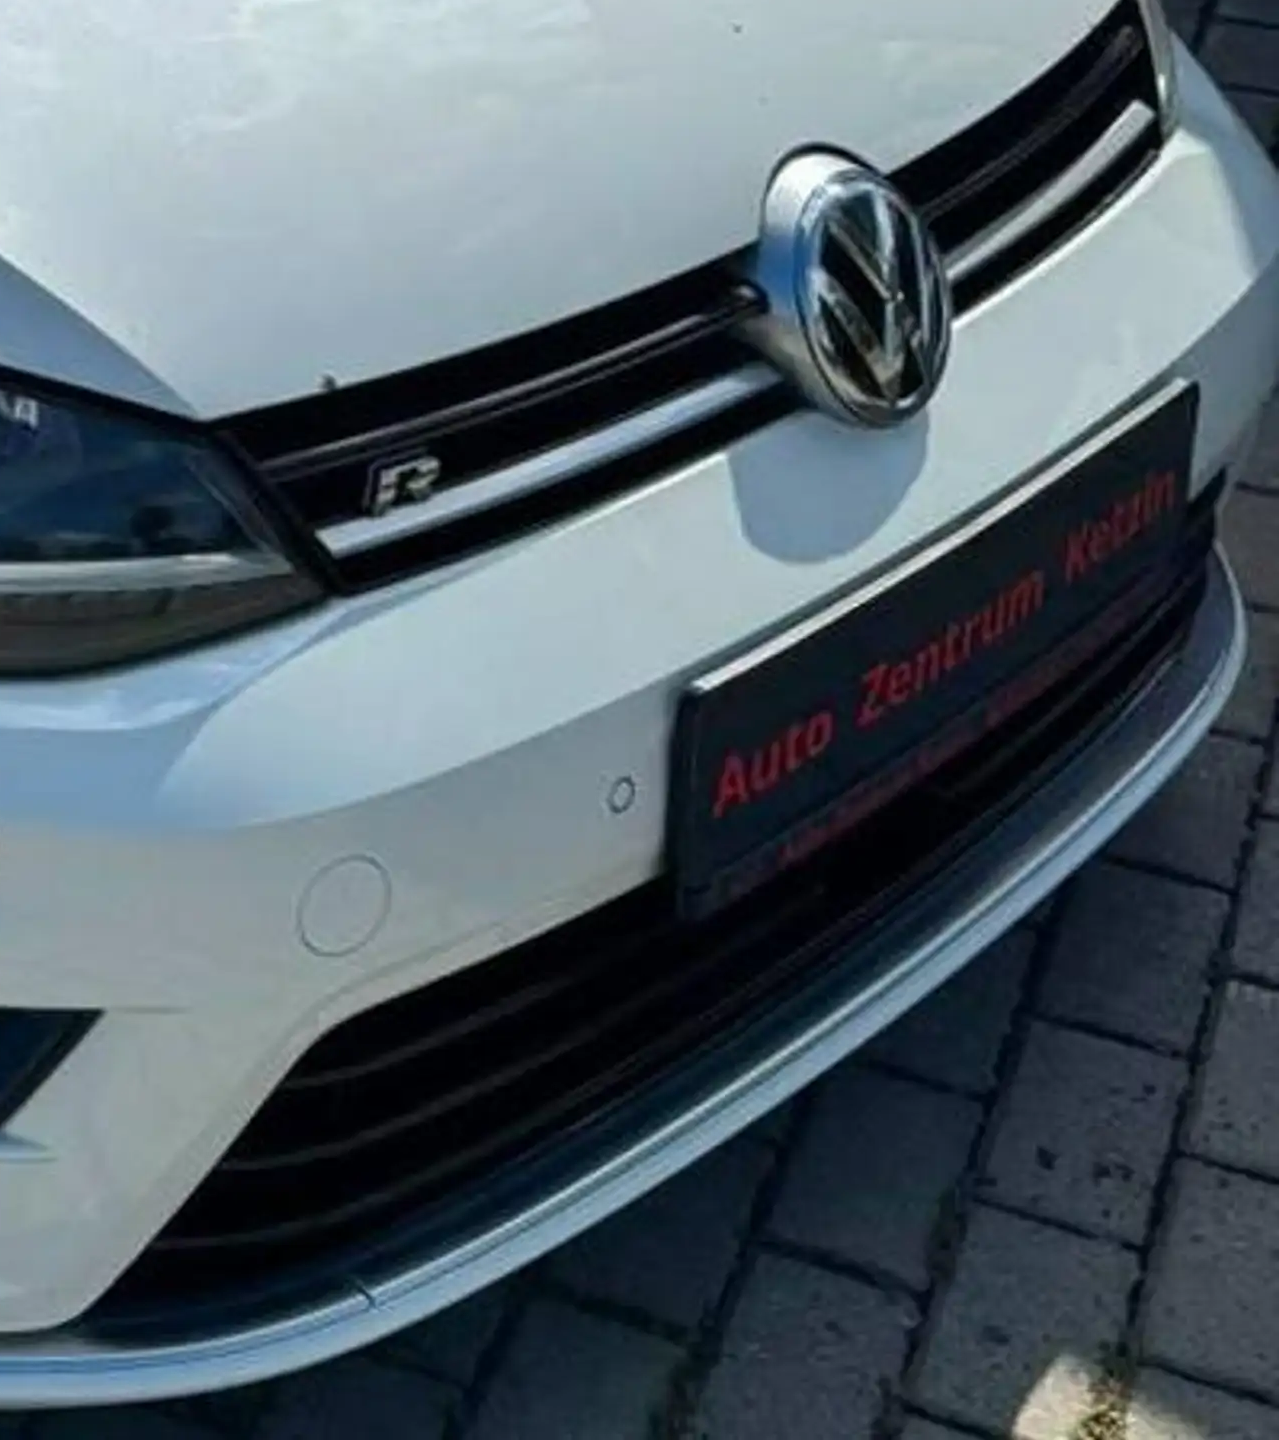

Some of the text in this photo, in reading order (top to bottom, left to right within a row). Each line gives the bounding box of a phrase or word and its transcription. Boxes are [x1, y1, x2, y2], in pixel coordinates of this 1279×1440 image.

[371, 455, 441, 516] R
[714, 713, 836, 817] Auto
[855, 572, 1045, 727] Zentrum
[1062, 472, 1175, 584] Ketzin
